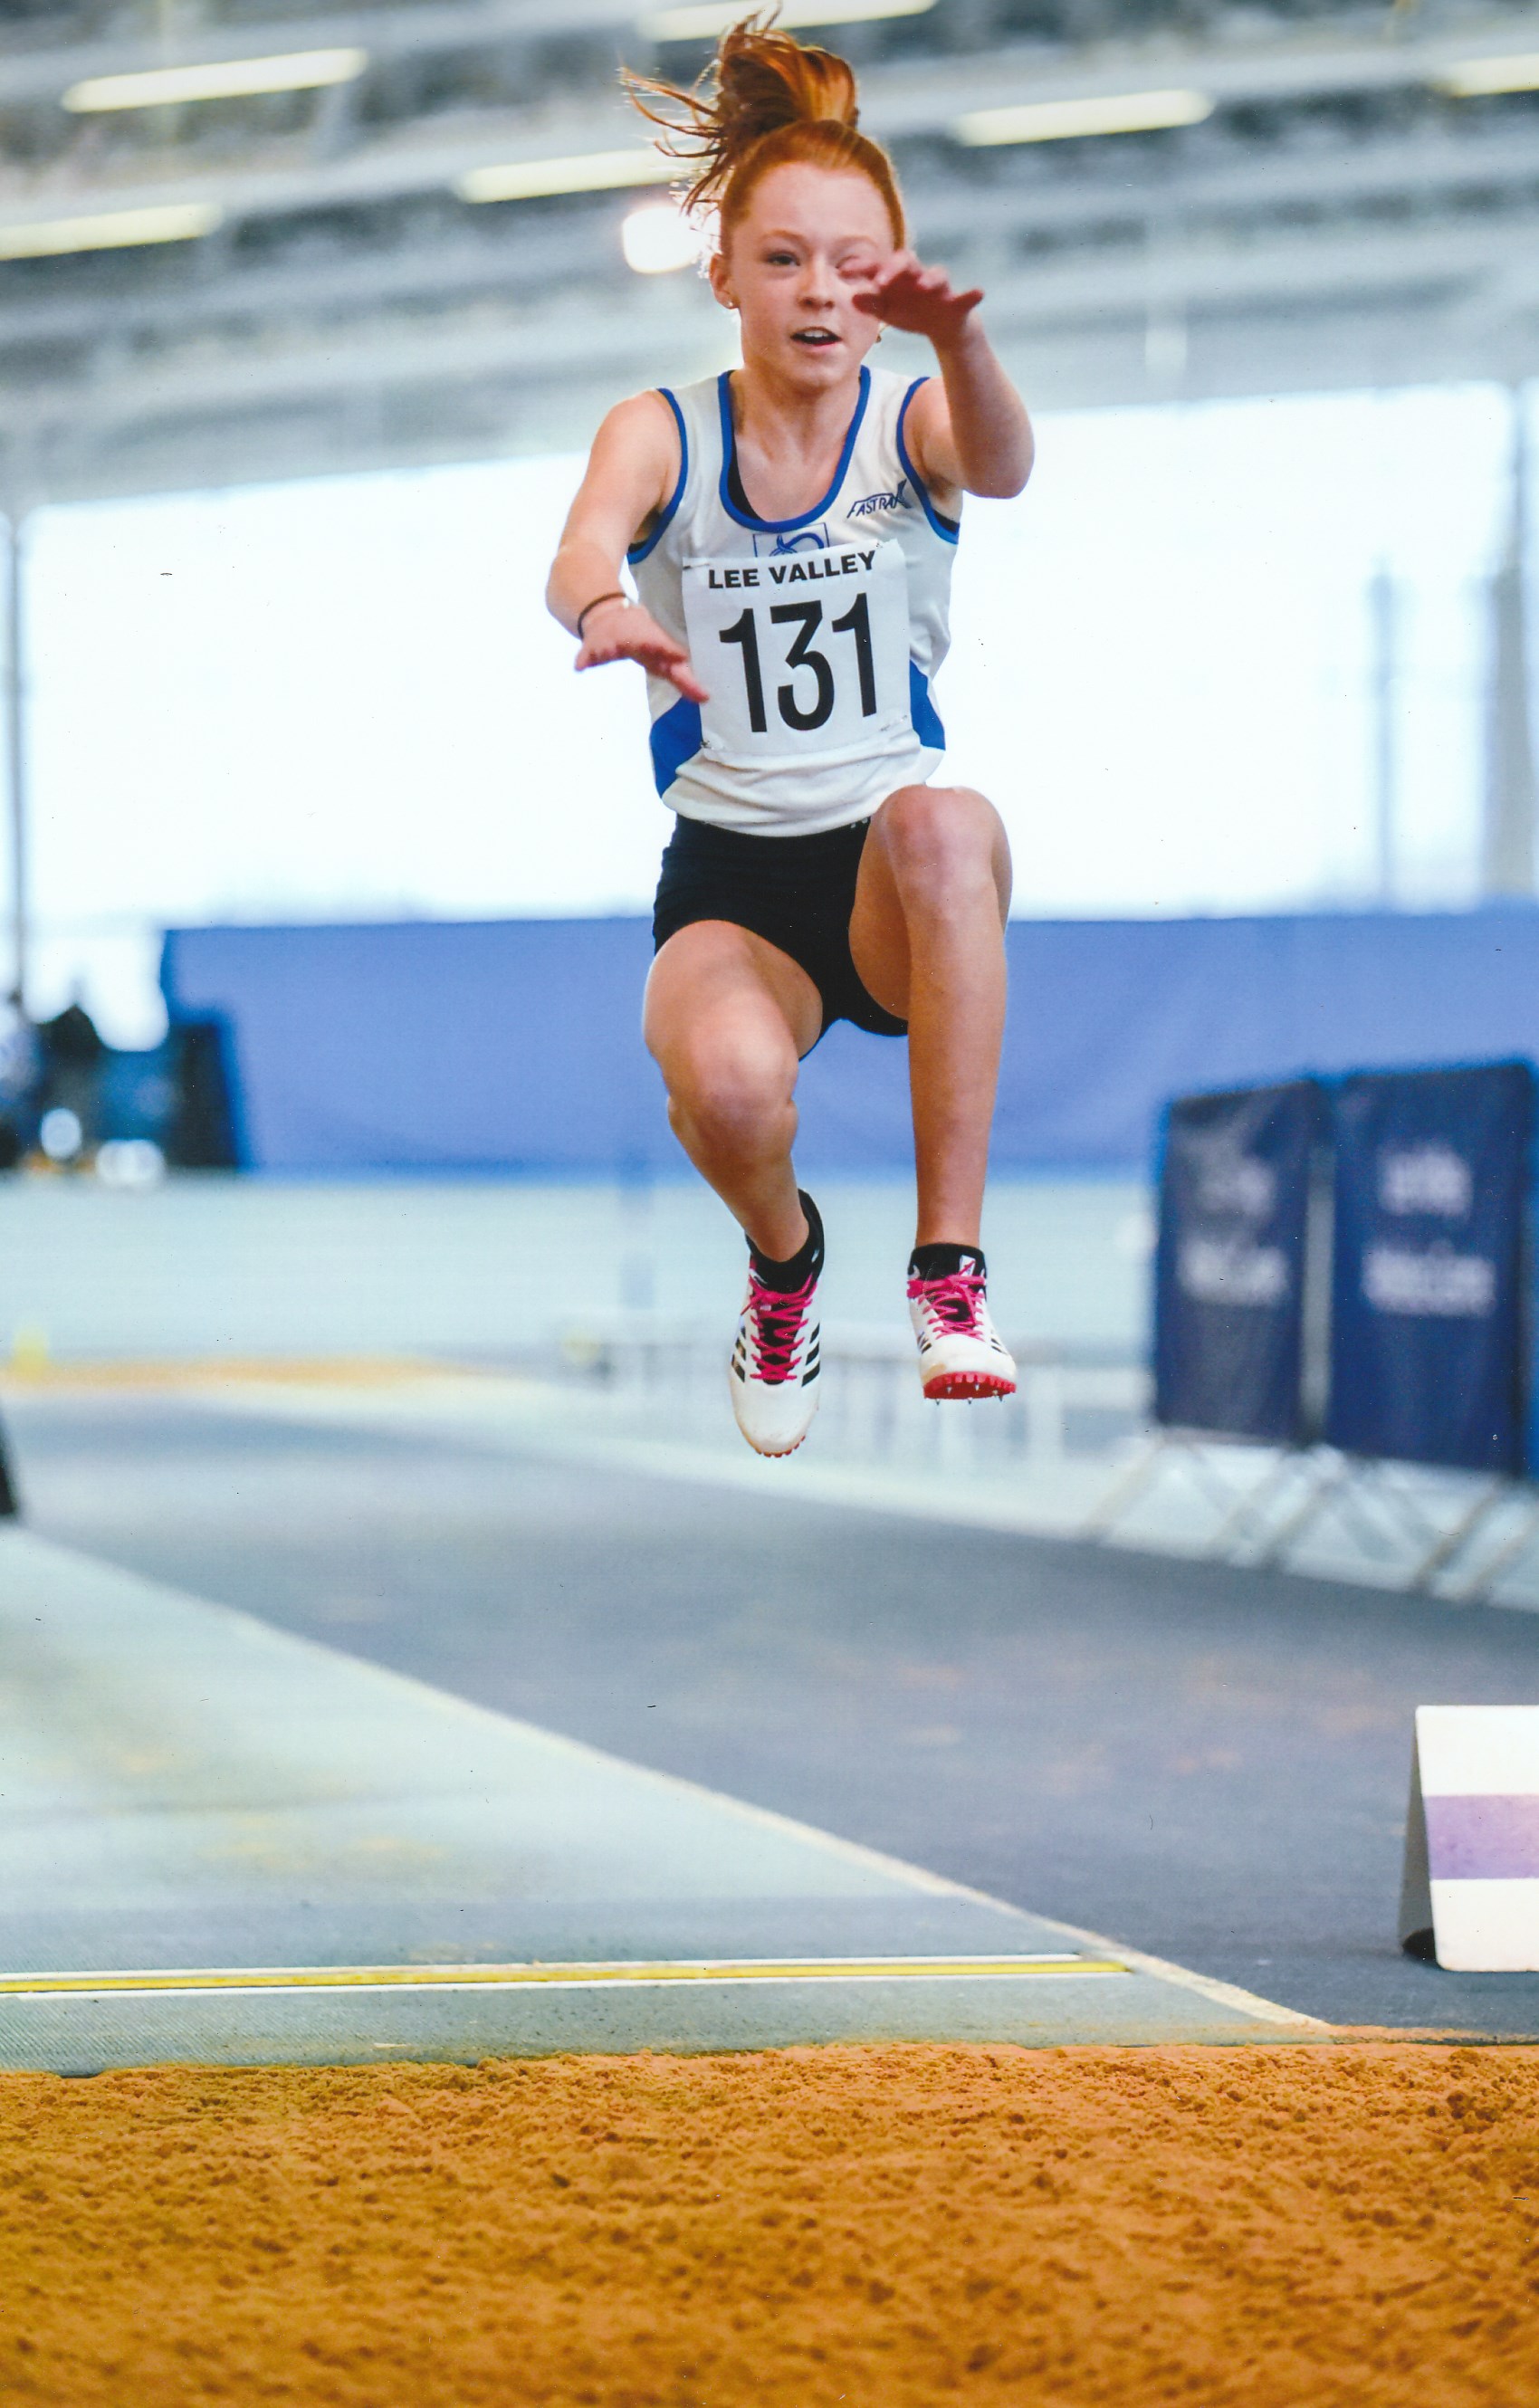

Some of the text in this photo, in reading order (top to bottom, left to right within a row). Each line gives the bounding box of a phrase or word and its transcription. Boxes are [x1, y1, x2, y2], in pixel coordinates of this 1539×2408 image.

[709, 550, 875, 589] LEE VALLEY
[719, 592, 877, 732] 131
